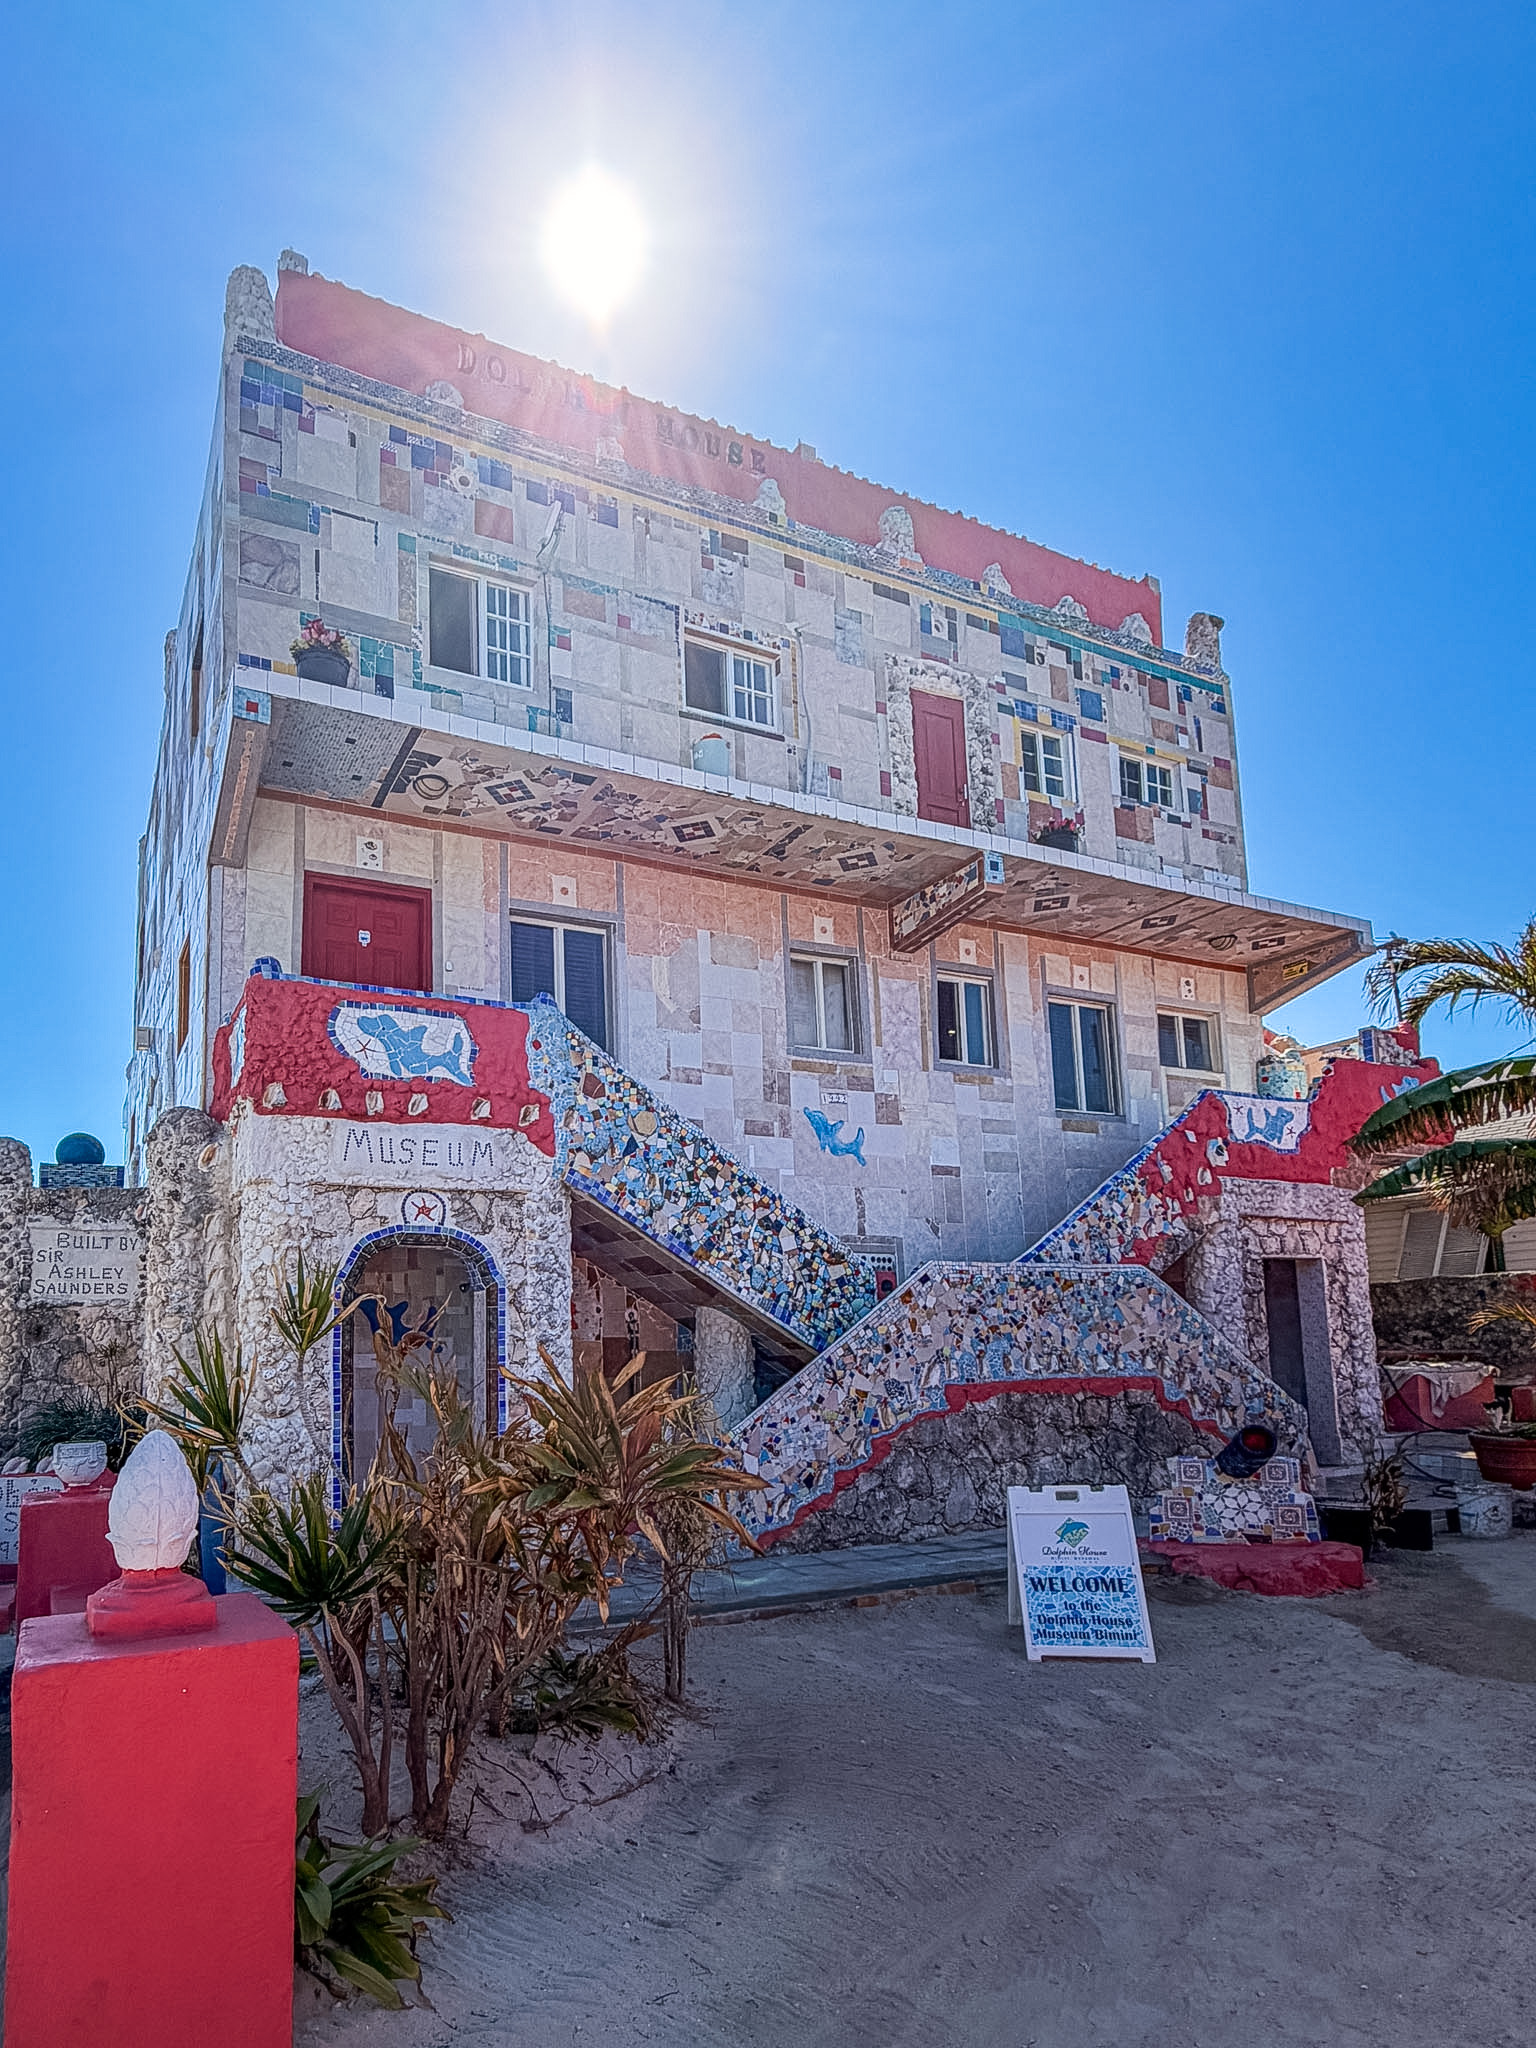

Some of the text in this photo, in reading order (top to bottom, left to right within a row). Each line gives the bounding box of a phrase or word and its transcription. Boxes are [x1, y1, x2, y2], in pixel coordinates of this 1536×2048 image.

[656, 413, 768, 474] HOUSE
[343, 1128, 494, 1167] MUSEUM
[119, 1237, 138, 1251] BY
[48, 1264, 124, 1279] ASHLEY
[32, 1279, 129, 1295] SAUNDERS
[1042, 1546, 1077, 1558] Dolphin
[1028, 1577, 1128, 1593] WELCOME
[1063, 1600, 1101, 1612] to the
[1036, 1614, 1133, 1627] Dolphin House
[1036, 1629, 1138, 1641] Museum Bimini
